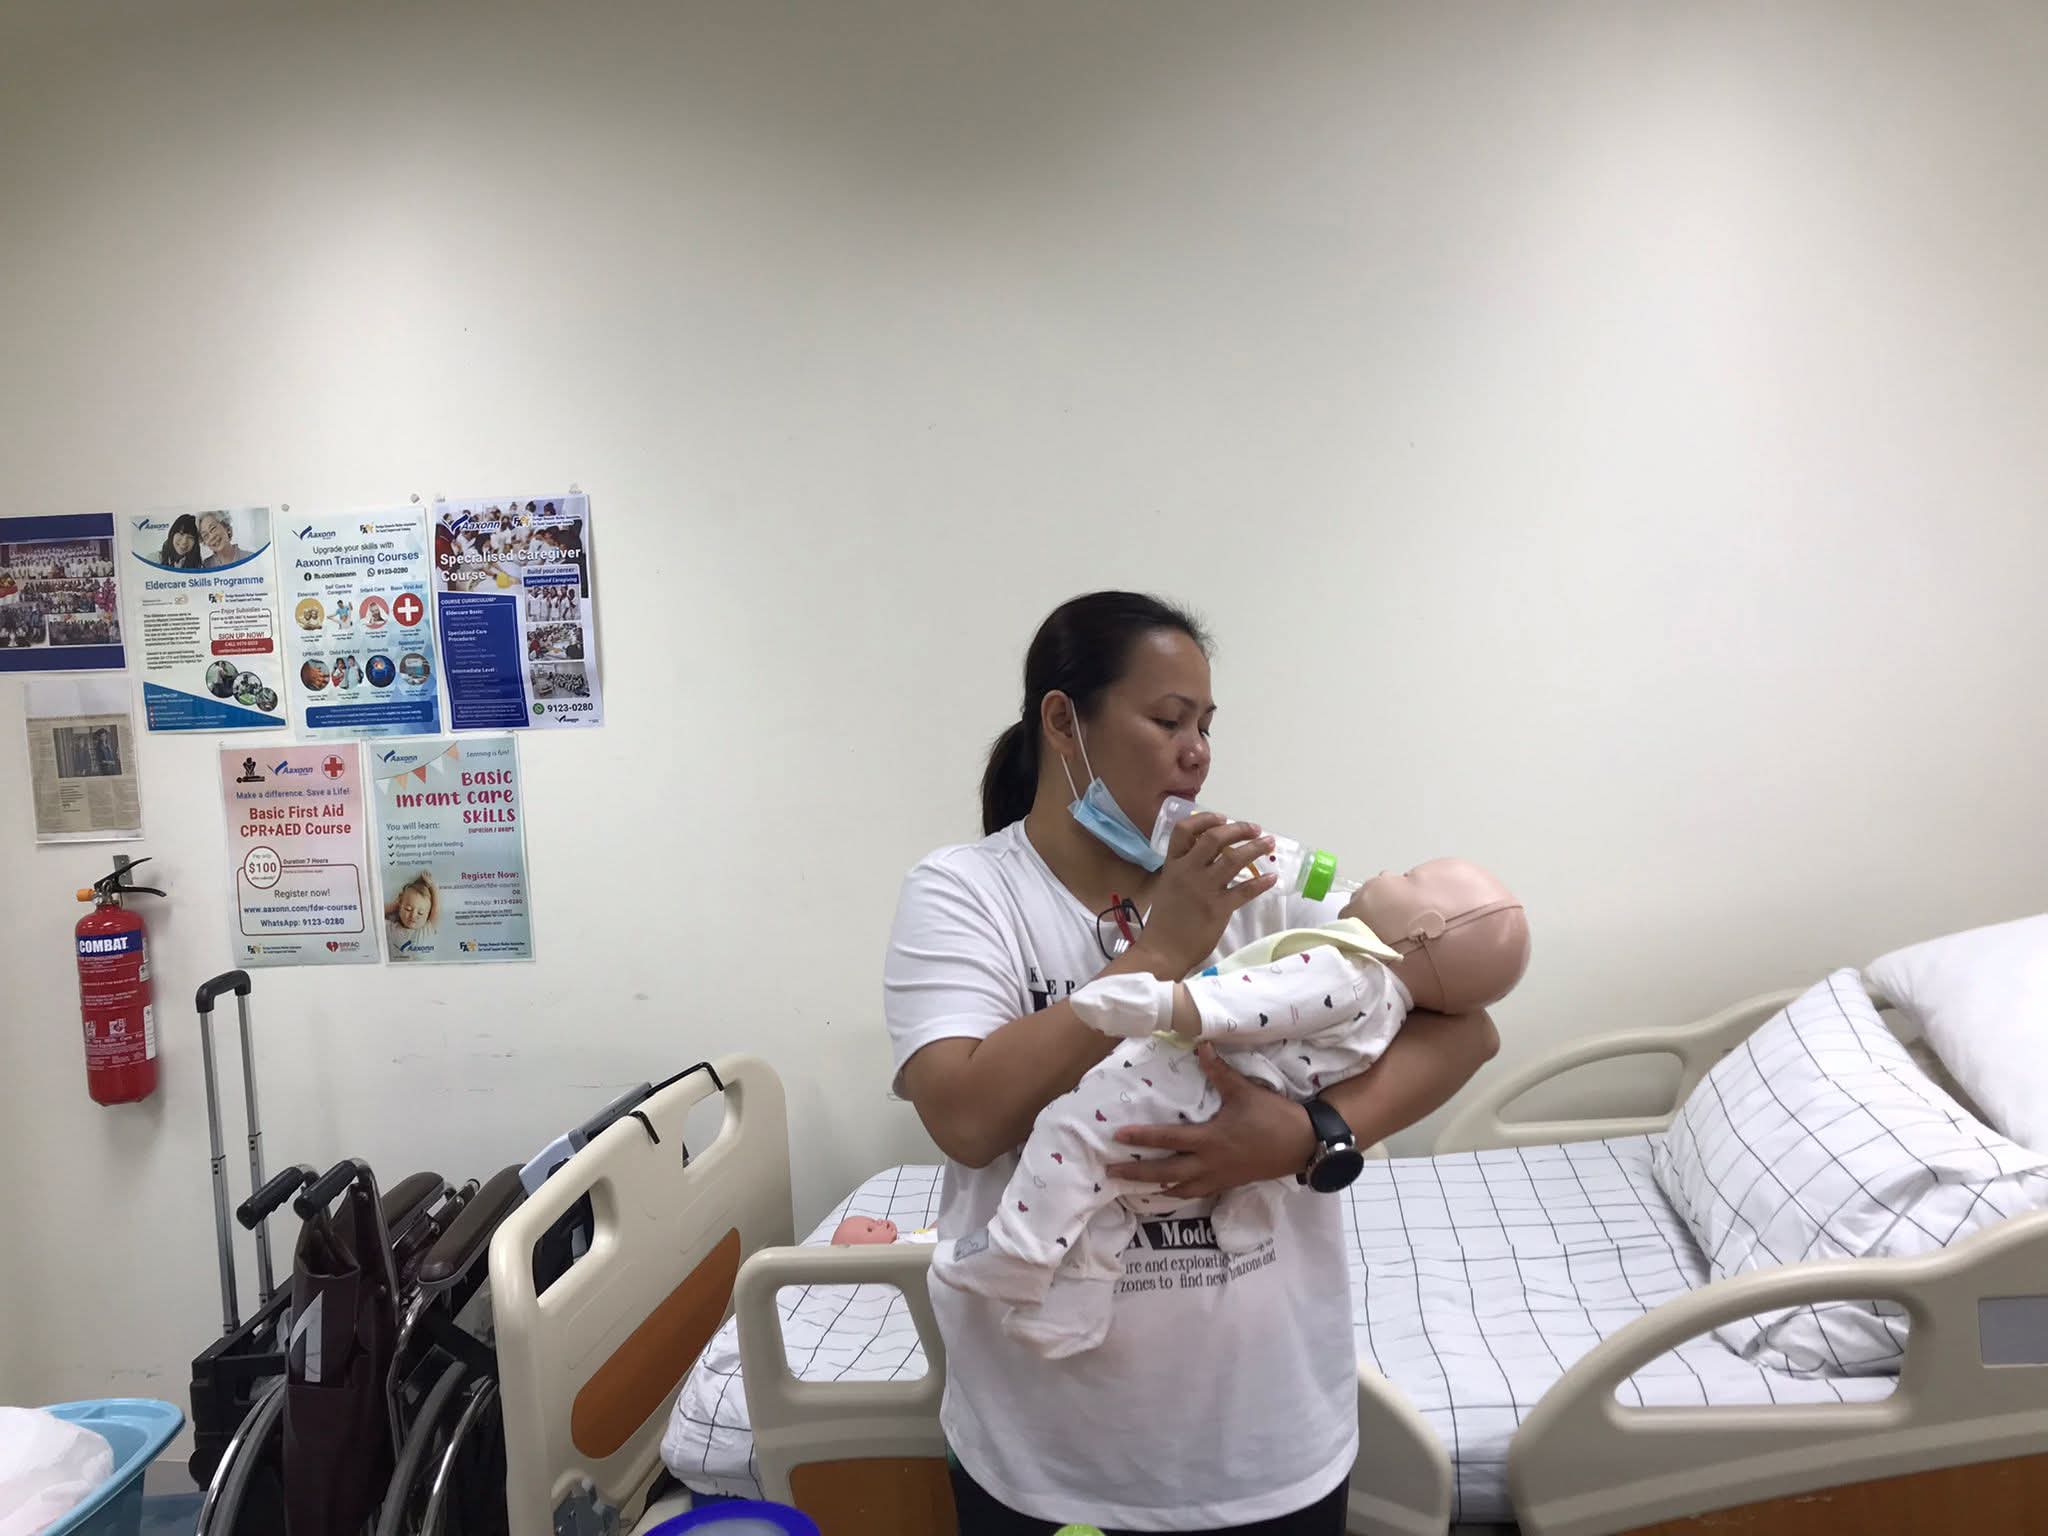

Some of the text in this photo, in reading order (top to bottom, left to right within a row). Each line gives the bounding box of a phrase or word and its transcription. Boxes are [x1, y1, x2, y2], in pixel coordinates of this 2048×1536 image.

[462, 521, 500, 530] Aaxonn
[307, 530, 336, 539] Aaxonn
[312, 542, 394, 555] Upgrade your skills with
[296, 552, 420, 568] Aaxonn Training Courses
[440, 548, 581, 566] Specialised Caregiver
[377, 567, 408, 576] 9123-0280
[441, 570, 486, 582] Course
[542, 568, 555, 576] your
[145, 576, 264, 591] Eldercare Skills Programme
[547, 702, 594, 712] 9123-0280
[282, 766, 313, 774] Aaxonn
[236, 792, 256, 800] Make
[306, 788, 324, 796] Save
[333, 788, 350, 796] Life!
[249, 804, 344, 820] Basic First Aid
[240, 822, 351, 838] CPR+AED Course
[386, 823, 400, 831] You
[418, 822, 440, 830] learn:
[248, 862, 276, 874] $100
[461, 872, 520, 880] Register Now:
[274, 888, 330, 900] Register now!
[244, 904, 358, 914] www.aaxonn.com/fdw-courses
[260, 918, 344, 928] WhatsApp: 9123-0280
[79, 936, 128, 953] COMBAT
[1120, 1278, 1156, 1292] zones
[1159, 1276, 1173, 1290] to
[1180, 1274, 1203, 1288] find
[1206, 1272, 1228, 1287] new
[1262, 1248, 1277, 1266] and
[1145, 1256, 1168, 1273] and
